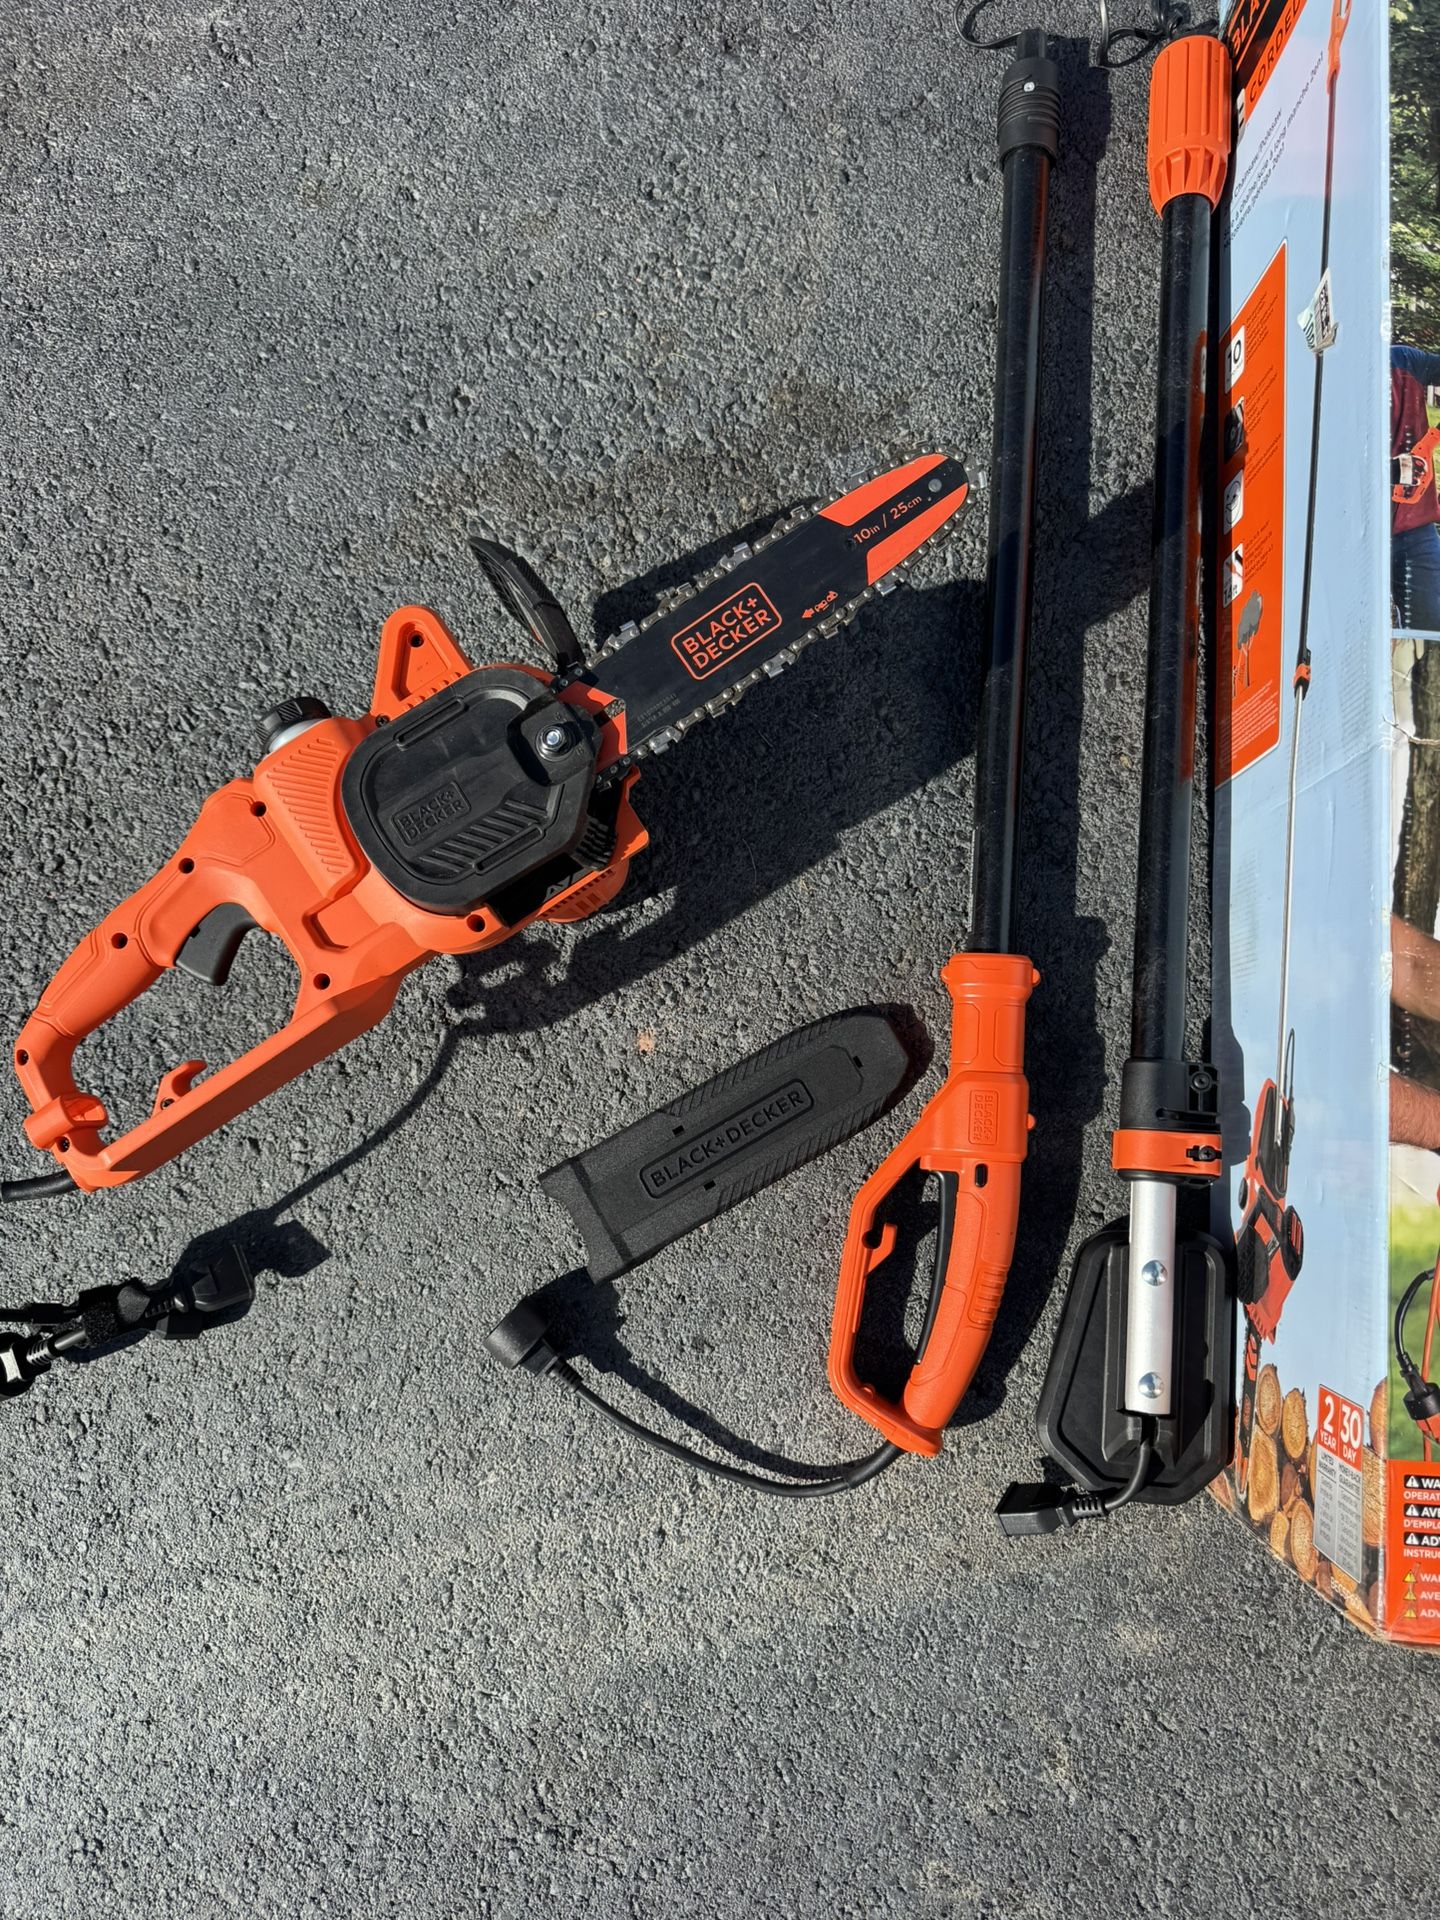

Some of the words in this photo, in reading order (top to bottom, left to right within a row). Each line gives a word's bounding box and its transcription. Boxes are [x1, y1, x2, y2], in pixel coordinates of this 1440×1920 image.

[853, 524, 881, 544] 10in
[889, 495, 923, 520] 25cm
[682, 597, 757, 654] BLACK+
[692, 609, 772, 669] DECKER
[397, 791, 455, 830] BLACK+
[404, 800, 465, 841] DECKER
[650, 1090, 804, 1187] BLACK+DECKER
[973, 1094, 984, 1140] DECKER
[984, 1095, 994, 1140] BLACK+
[1323, 1395, 1335, 1434] 2
[1340, 1403, 1361, 1450] 30
[1320, 1430, 1337, 1451] YEAR
[1342, 1445, 1357, 1463] DAY
